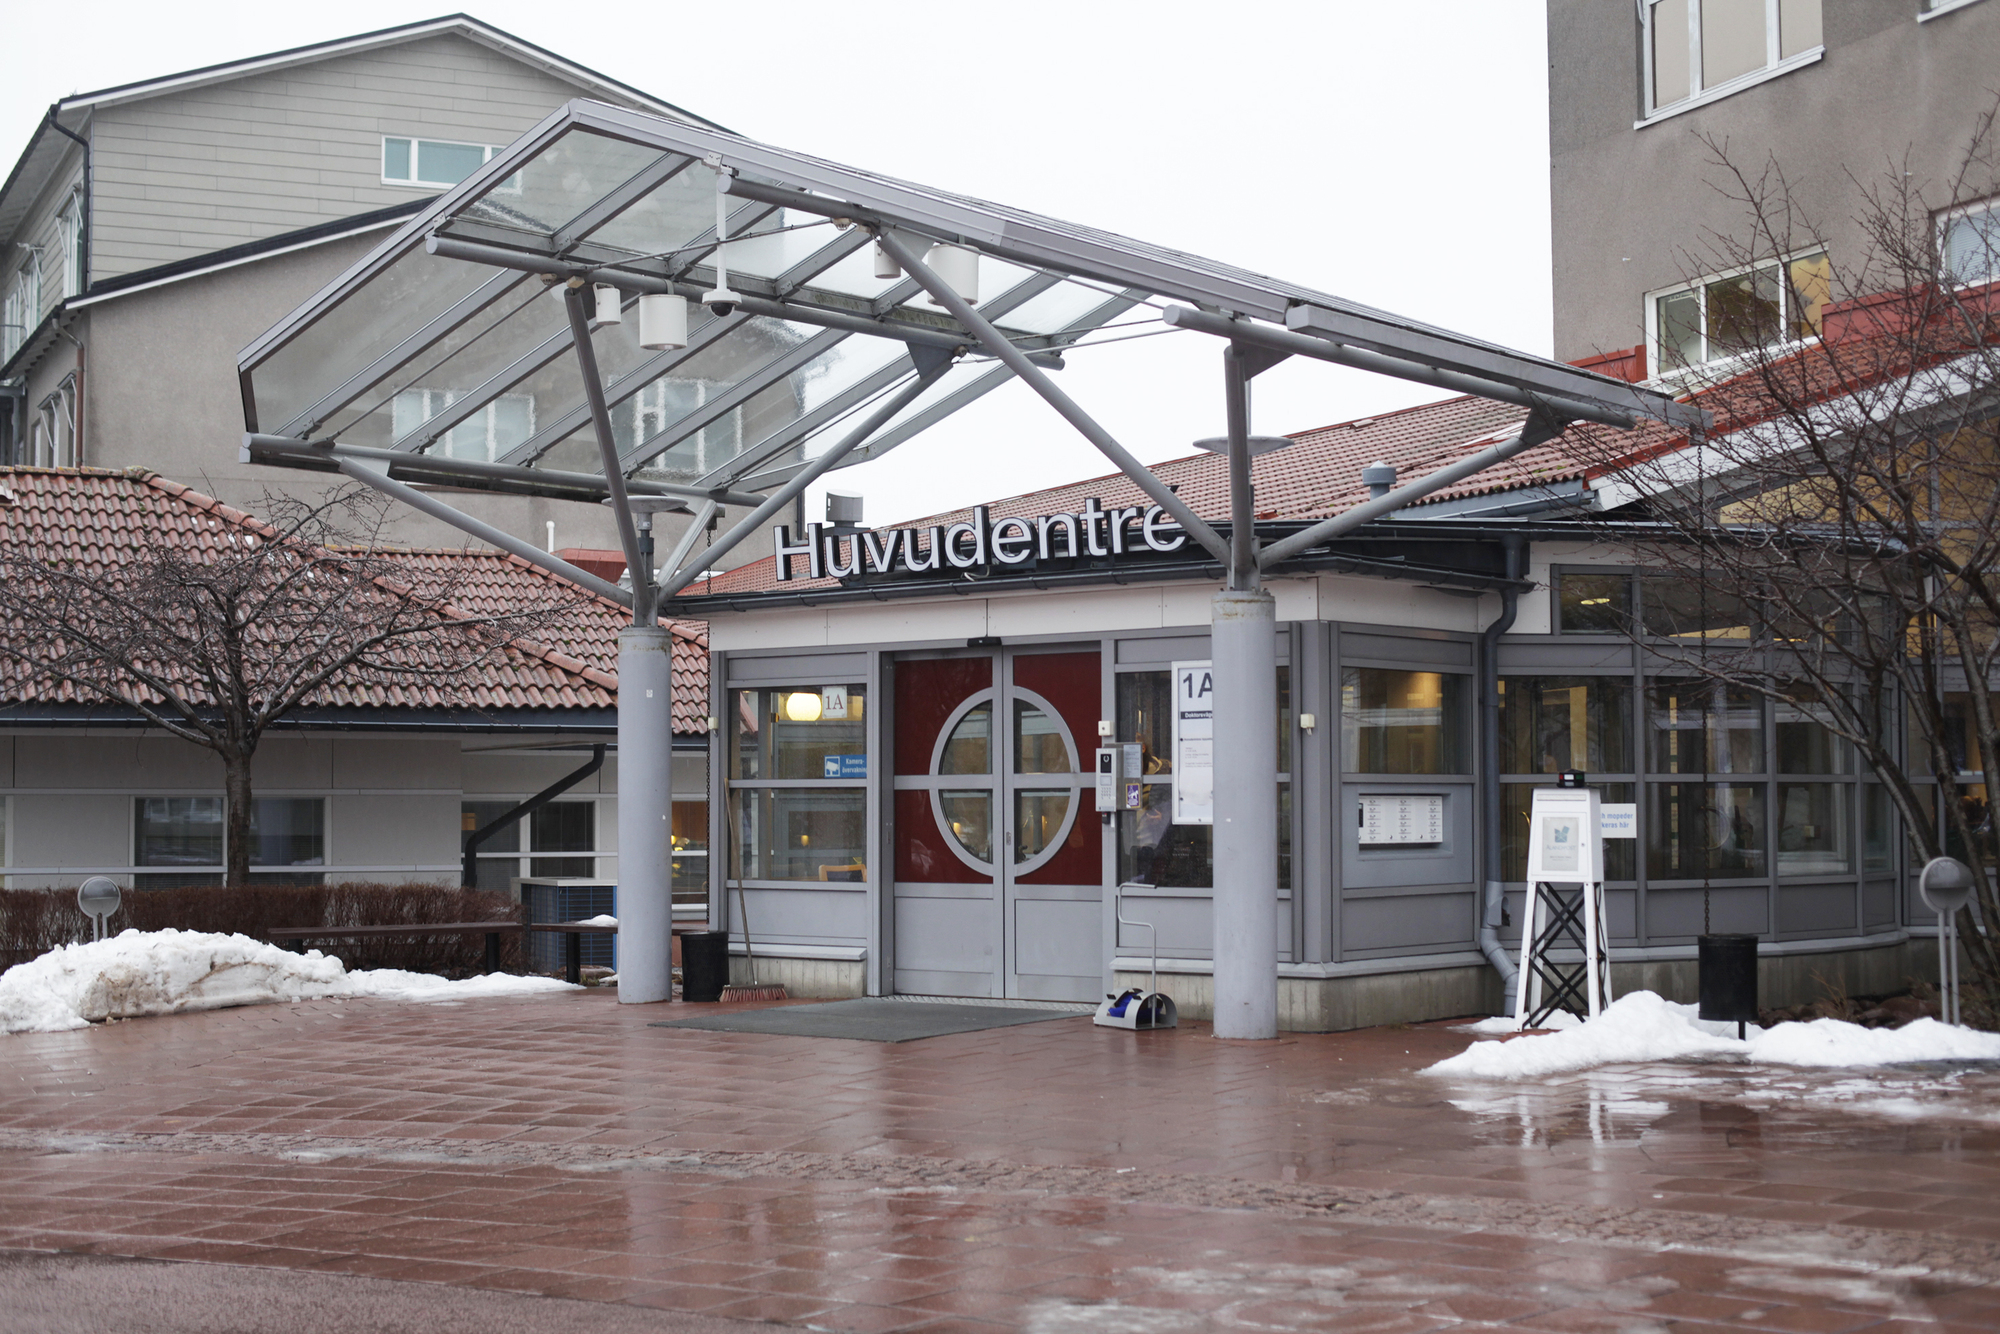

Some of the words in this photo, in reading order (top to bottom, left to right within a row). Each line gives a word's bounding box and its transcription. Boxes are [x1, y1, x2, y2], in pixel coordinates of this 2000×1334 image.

[1183, 673, 1212, 698] 1A
[825, 694, 844, 710] 1A
[1185, 711, 1212, 719] Doktorsväg
[1607, 812, 1633, 820] mopeder
